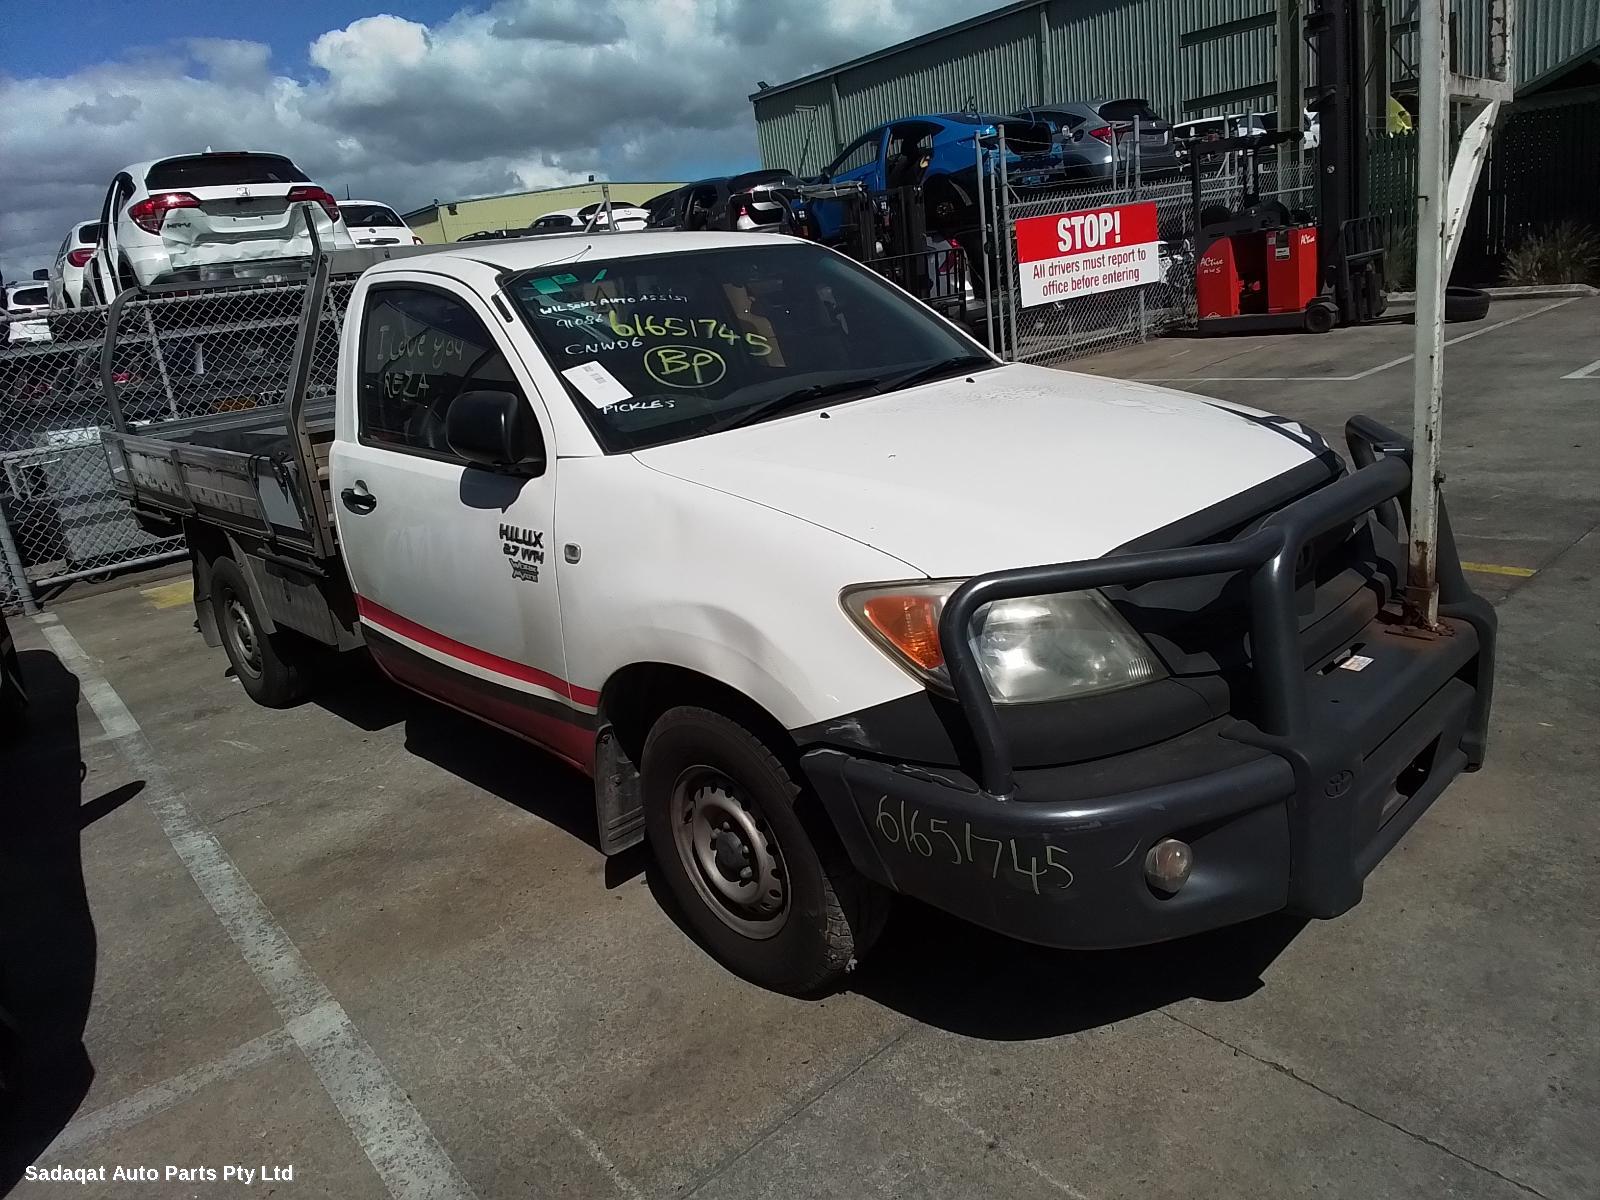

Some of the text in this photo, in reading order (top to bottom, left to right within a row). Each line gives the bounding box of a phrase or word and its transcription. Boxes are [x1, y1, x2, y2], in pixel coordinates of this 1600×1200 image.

[1057, 210, 1121, 252] STOP!
[1033, 247, 1147, 280] All drivers must report to
[1042, 267, 1140, 297] office before entering
[600, 297, 636, 306] AUTO
[377, 324, 390, 361] I
[432, 337, 465, 369] you
[608, 310, 773, 357] 61651745
[655, 349, 714, 384] BP
[602, 399, 676, 415] PICKLES
[499, 523, 544, 549] HILUX
[876, 794, 1075, 896] 61651745
